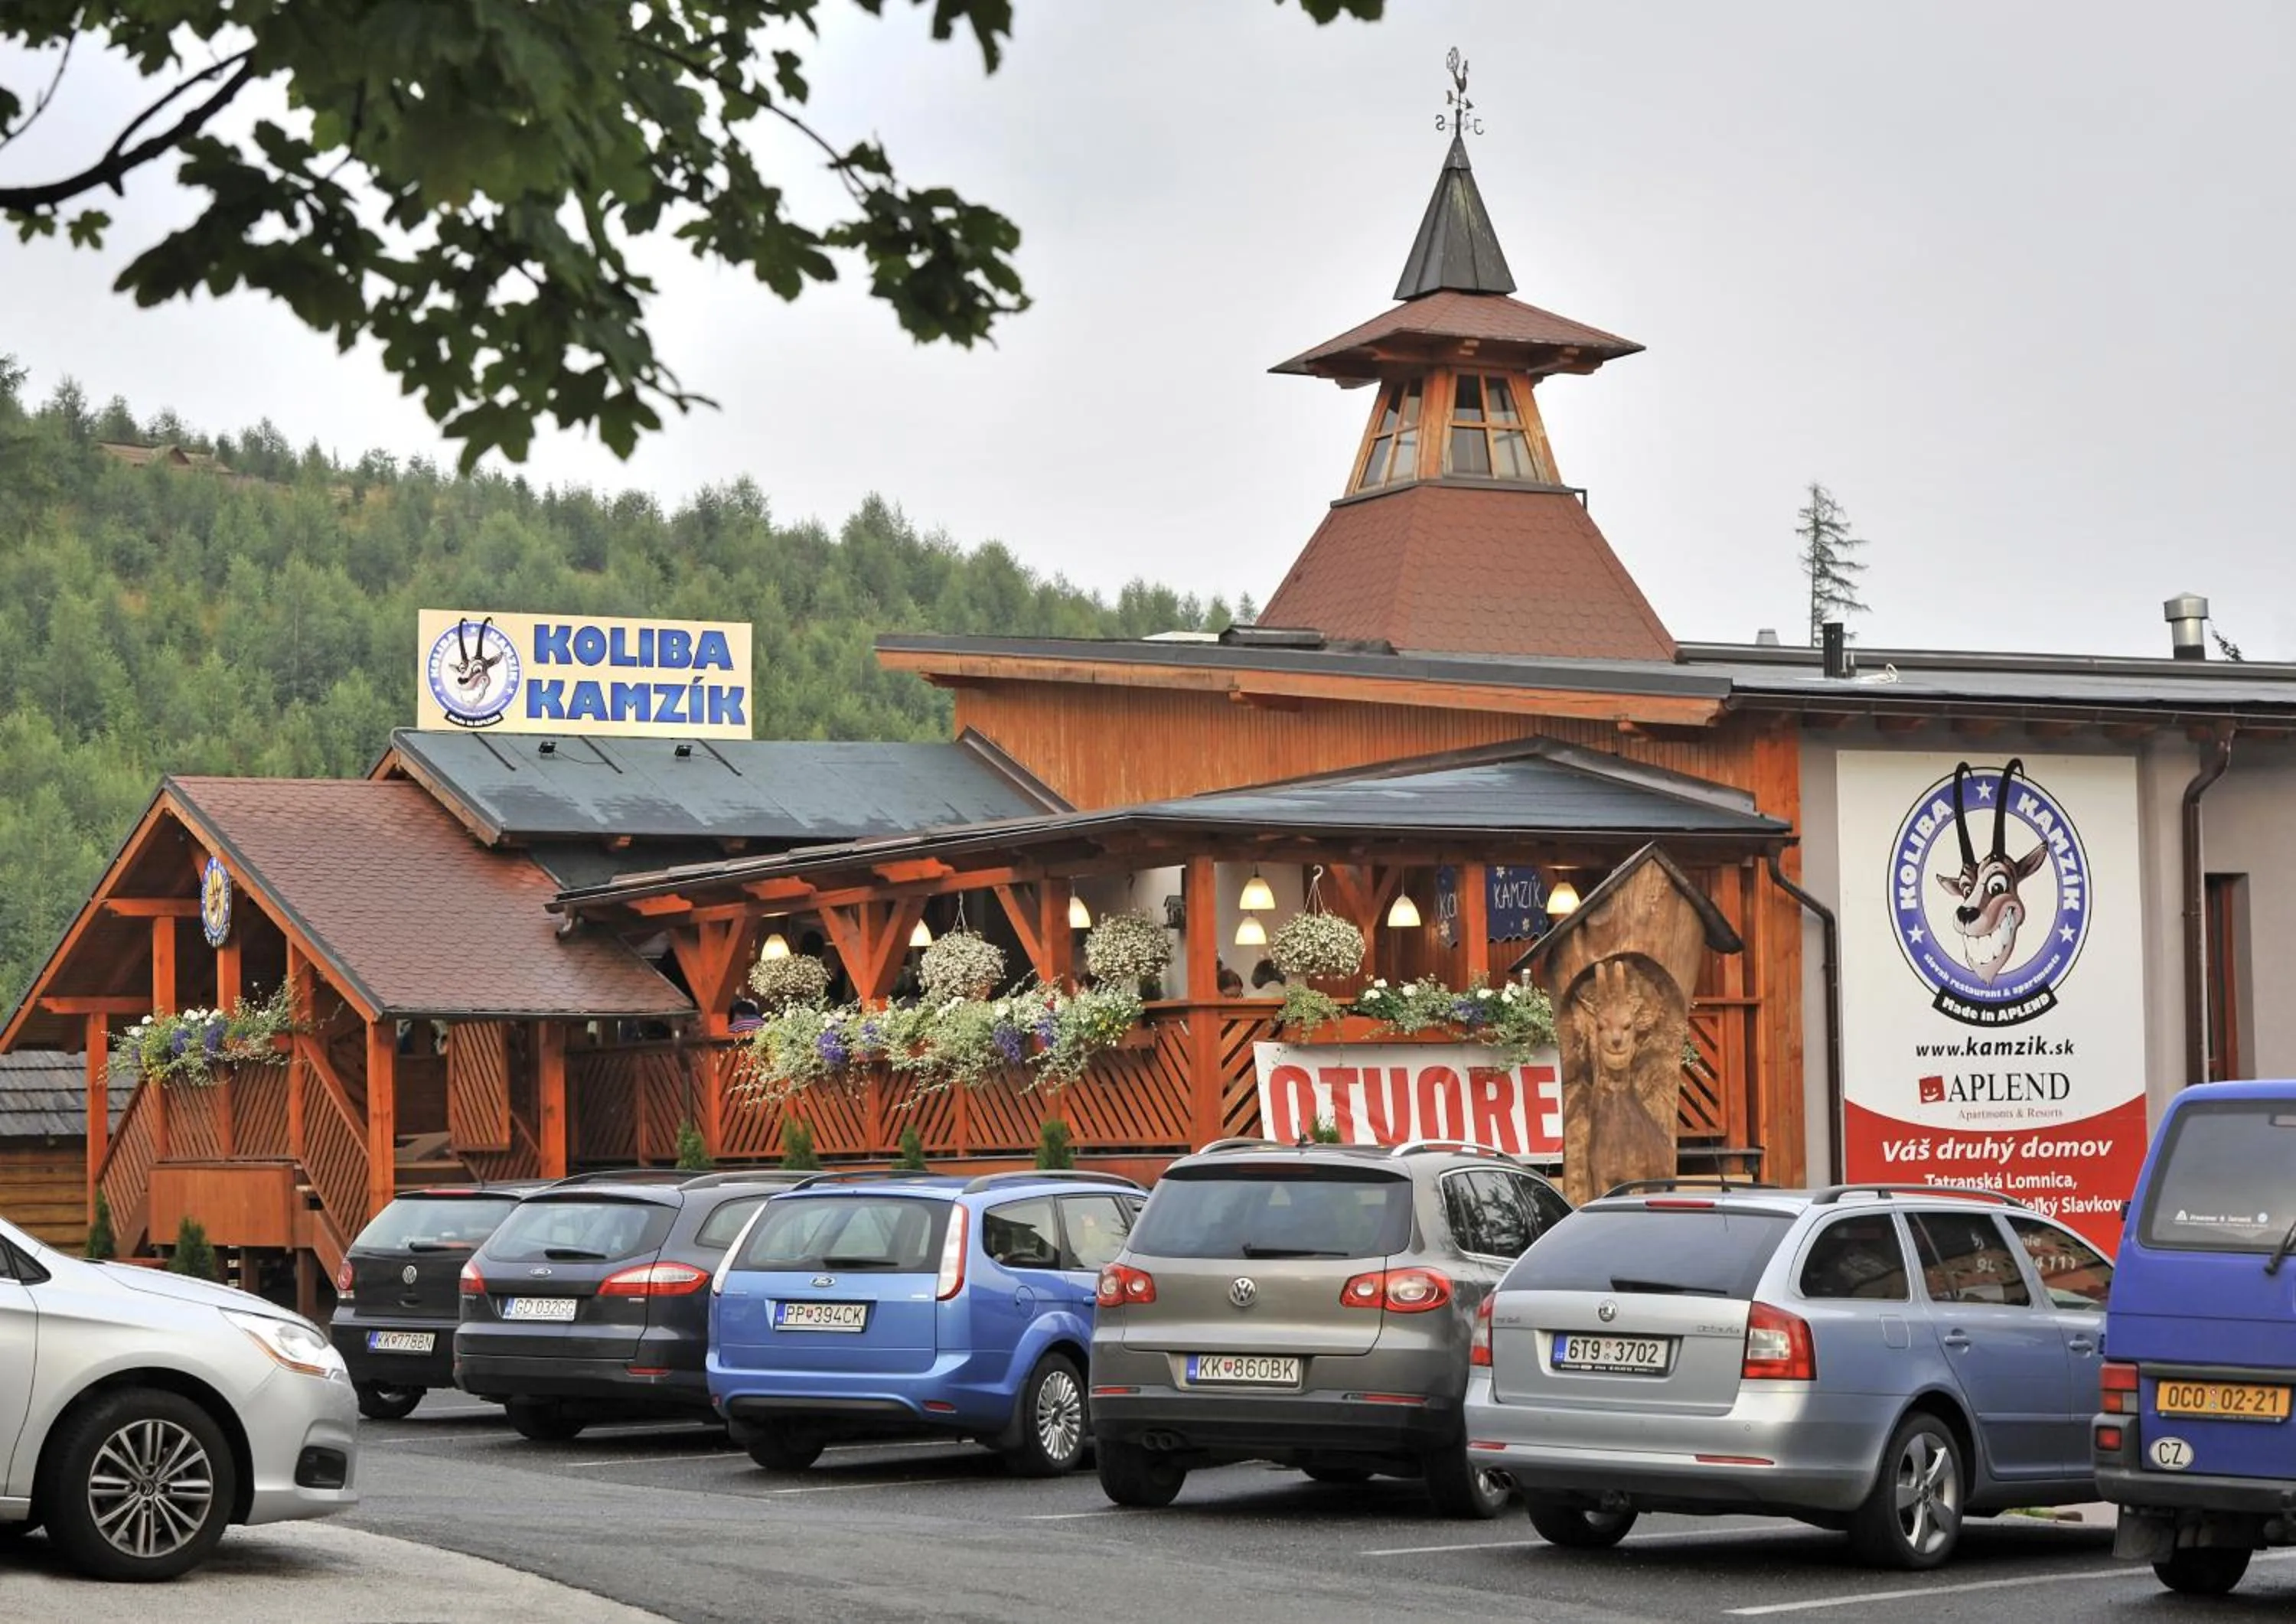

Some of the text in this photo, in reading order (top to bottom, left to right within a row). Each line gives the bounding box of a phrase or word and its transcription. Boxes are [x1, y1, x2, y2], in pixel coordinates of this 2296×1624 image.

[533, 624, 735, 670] KOLIBA
[526, 676, 746, 726] KAMZÍK
[1898, 791, 2082, 911] KOLIBA KAMZÍK
[1949, 978, 2002, 999] restaurant
[1941, 993, 2051, 1022] Made in APLEND
[1915, 1035, 2075, 1057] www.kamzik.sk
[1947, 1071, 2071, 1103] APLEND
[1268, 1064, 1563, 1156] OTVORE
[1958, 1107, 2063, 1121] Apartments & Resorts
[1881, 1135, 2114, 1166] Váš druhý domov
[1924, 1171, 2078, 1191] Tatranská Lomnica,
[2061, 1194, 2123, 1214] Slavkov
[785, 1306, 864, 1324] PP 394CK
[1568, 1336, 1659, 1365] 6T9 3702
[1199, 1357, 1296, 1380] KK 860BK
[2220, 1388, 2279, 1413] 02-21
[2158, 1441, 2183, 1466] CZ
